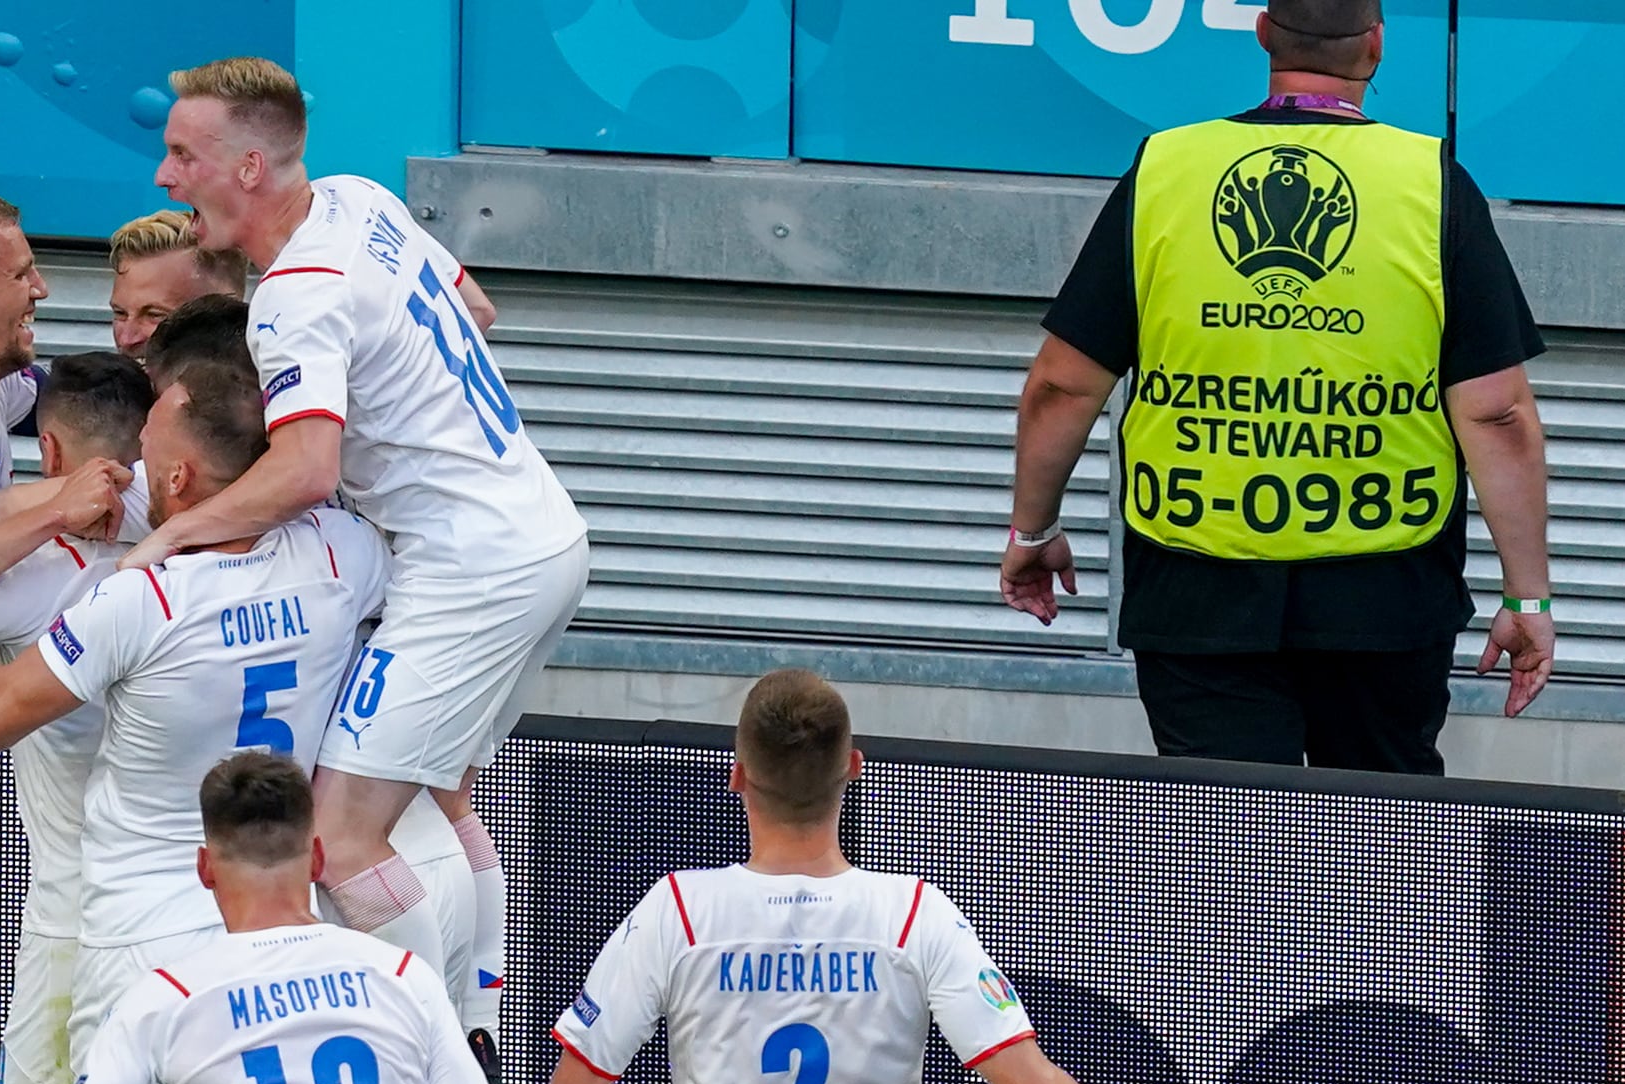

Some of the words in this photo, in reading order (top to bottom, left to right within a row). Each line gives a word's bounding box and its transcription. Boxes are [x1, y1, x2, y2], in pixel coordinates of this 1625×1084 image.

[1255, 278, 1303, 299] UEFA
[1201, 302, 1364, 335] EURO2020
[1176, 416, 1382, 459] STEWARD
[1134, 461, 1439, 534] 05-0985
[220, 595, 310, 648] COUFAL
[338, 646, 396, 719] 13
[720, 943, 879, 994] KADEŘÁBEK
[227, 971, 372, 1030] MASOPUST
